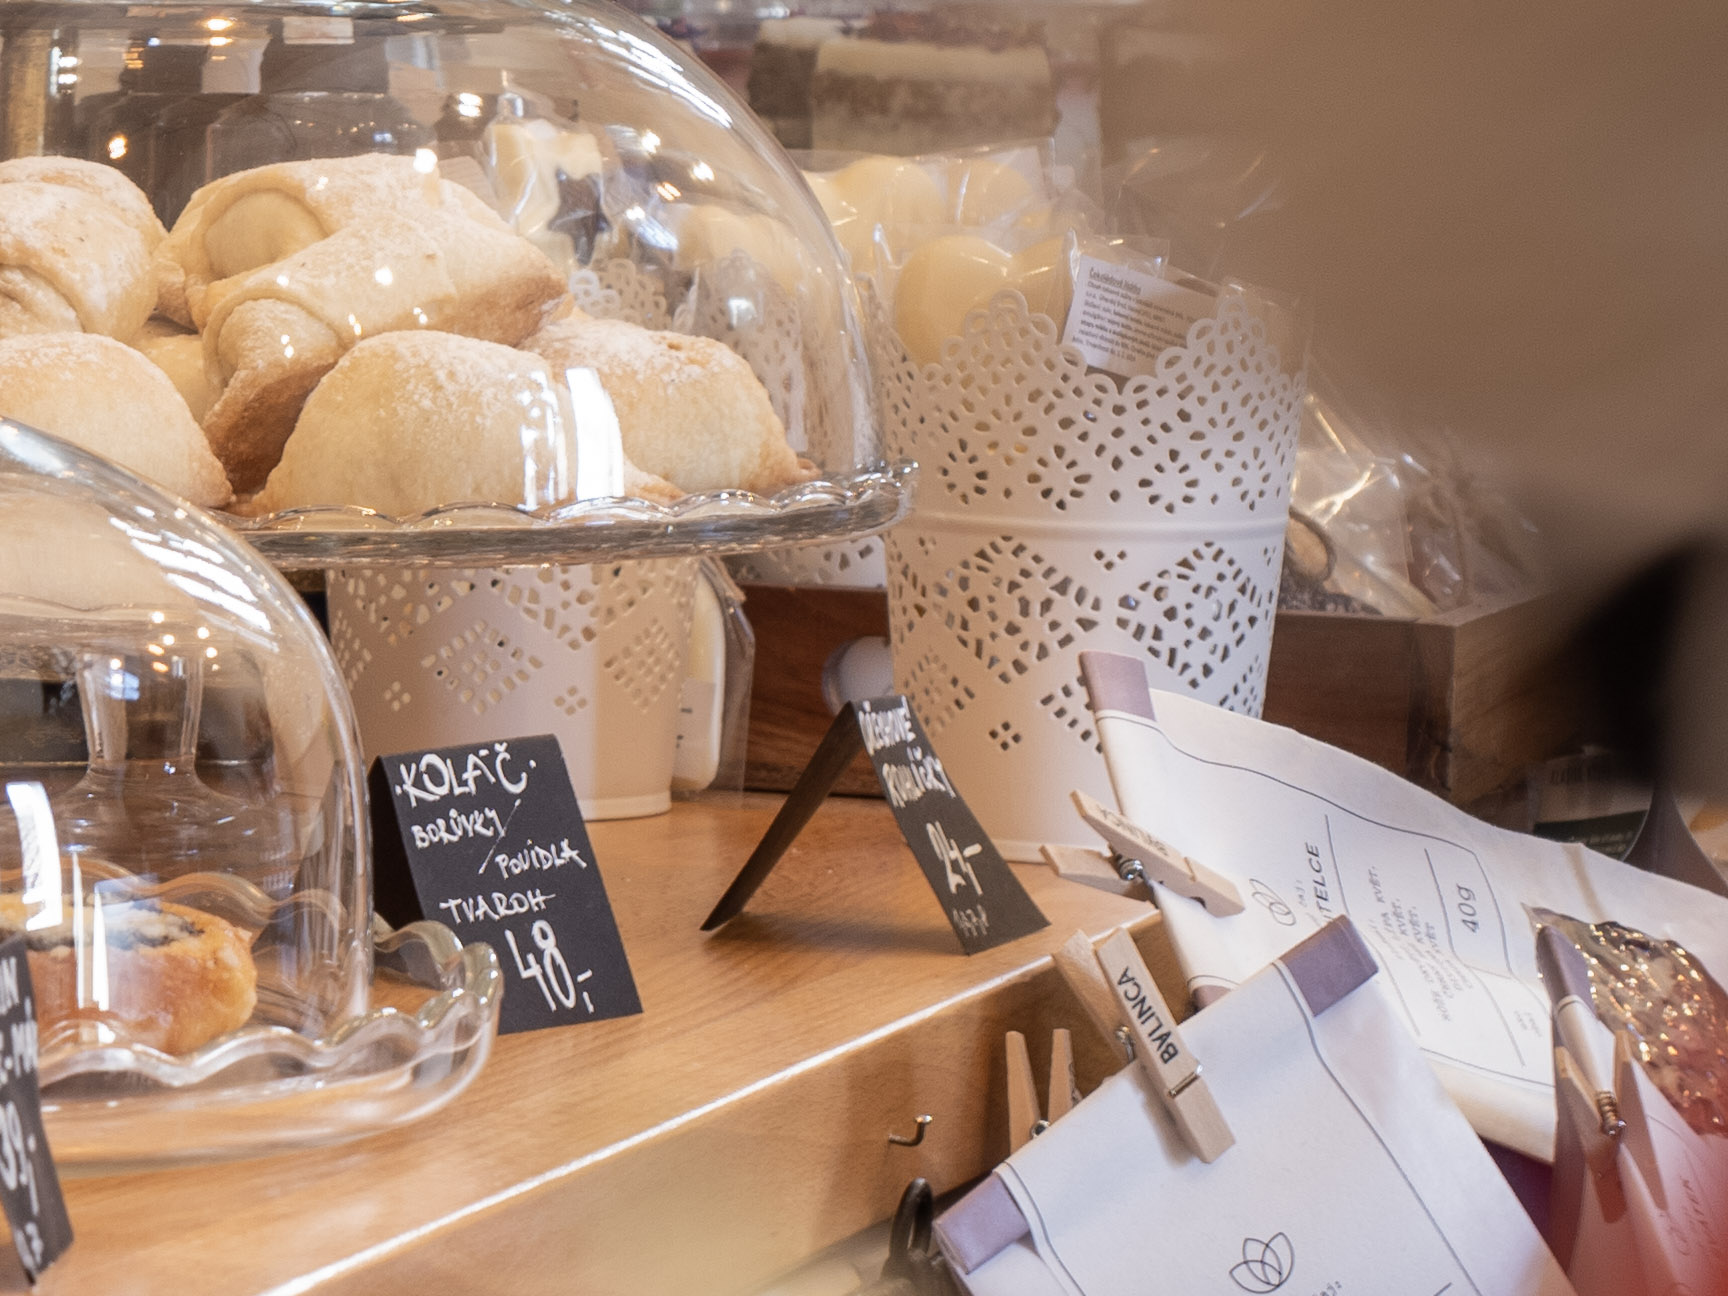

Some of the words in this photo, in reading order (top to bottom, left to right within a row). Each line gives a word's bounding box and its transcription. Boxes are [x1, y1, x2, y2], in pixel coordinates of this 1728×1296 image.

[438, 888, 557, 925] TVAROH
[1305, 841, 1337, 921] ITELCE
[1456, 882, 1480, 935] 40g
[1116, 965, 1180, 1065] BYLINCA
